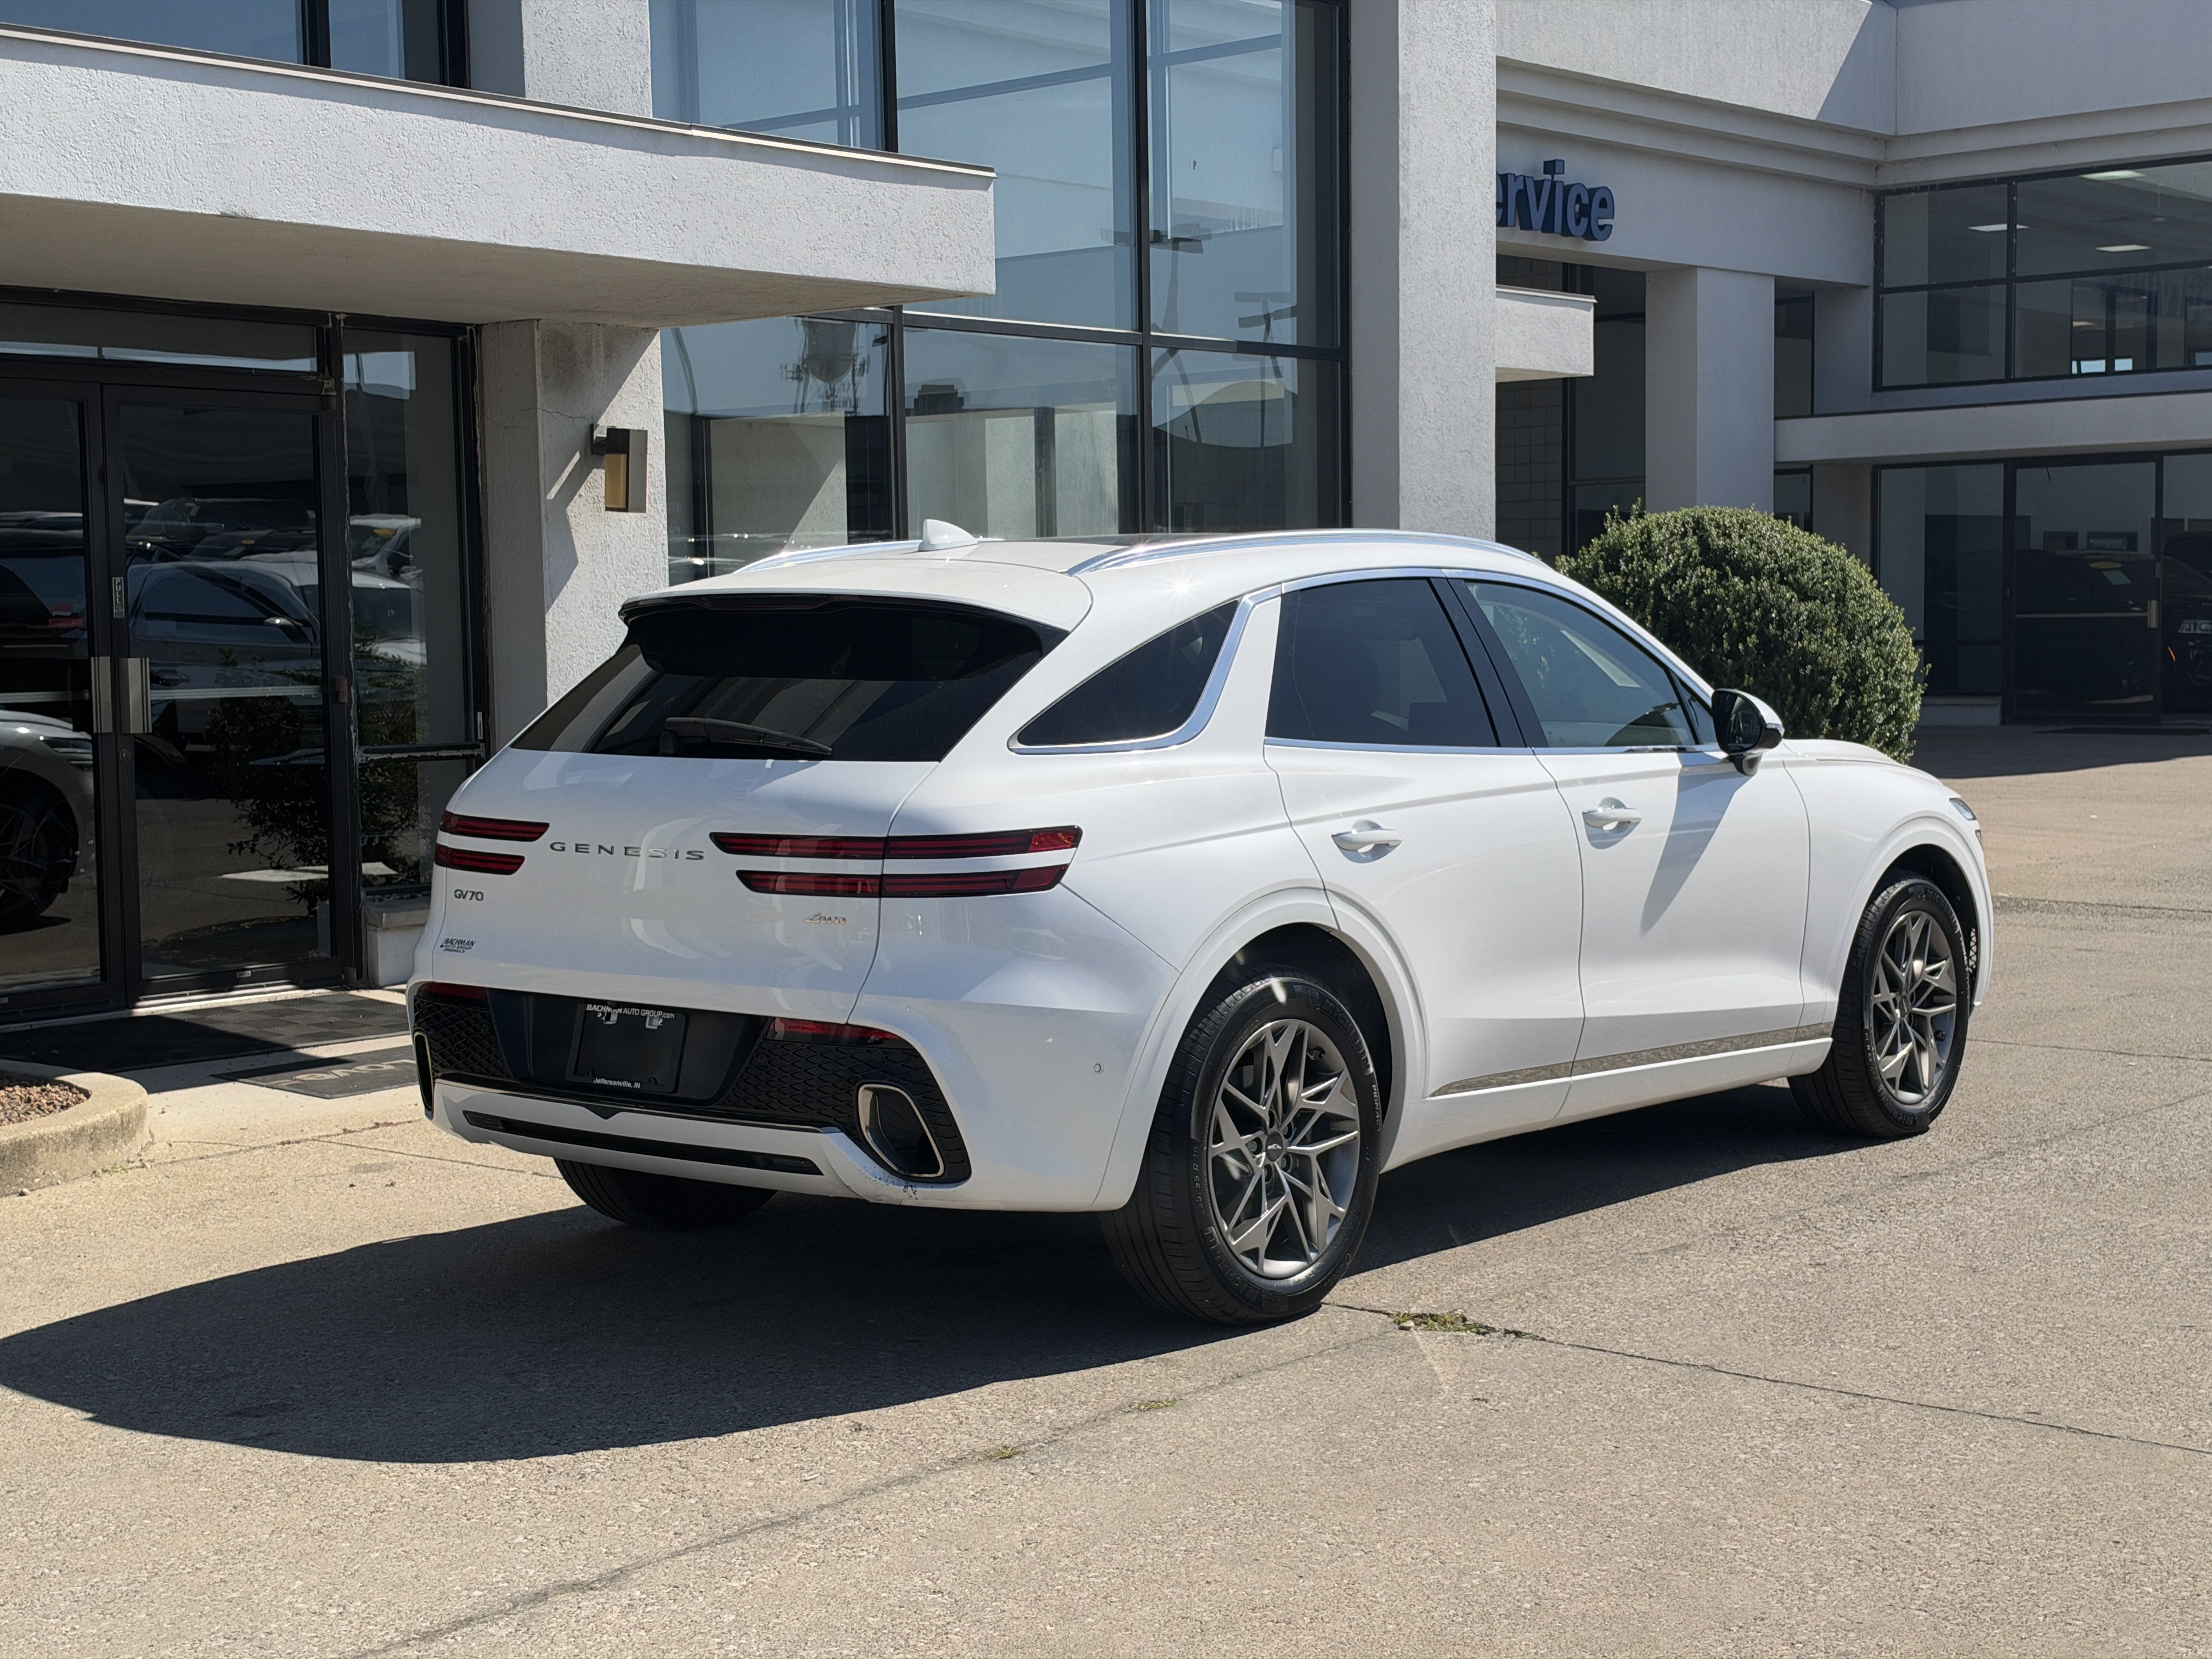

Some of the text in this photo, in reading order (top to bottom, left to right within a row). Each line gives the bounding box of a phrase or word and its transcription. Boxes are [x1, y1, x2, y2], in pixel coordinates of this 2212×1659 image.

[549, 841, 704, 860] GENESIS
[454, 889, 484, 901] GV70
[443, 938, 476, 947] BACHMAN
[586, 1003, 675, 1019] BACHMAN AUTO GROUP.com
